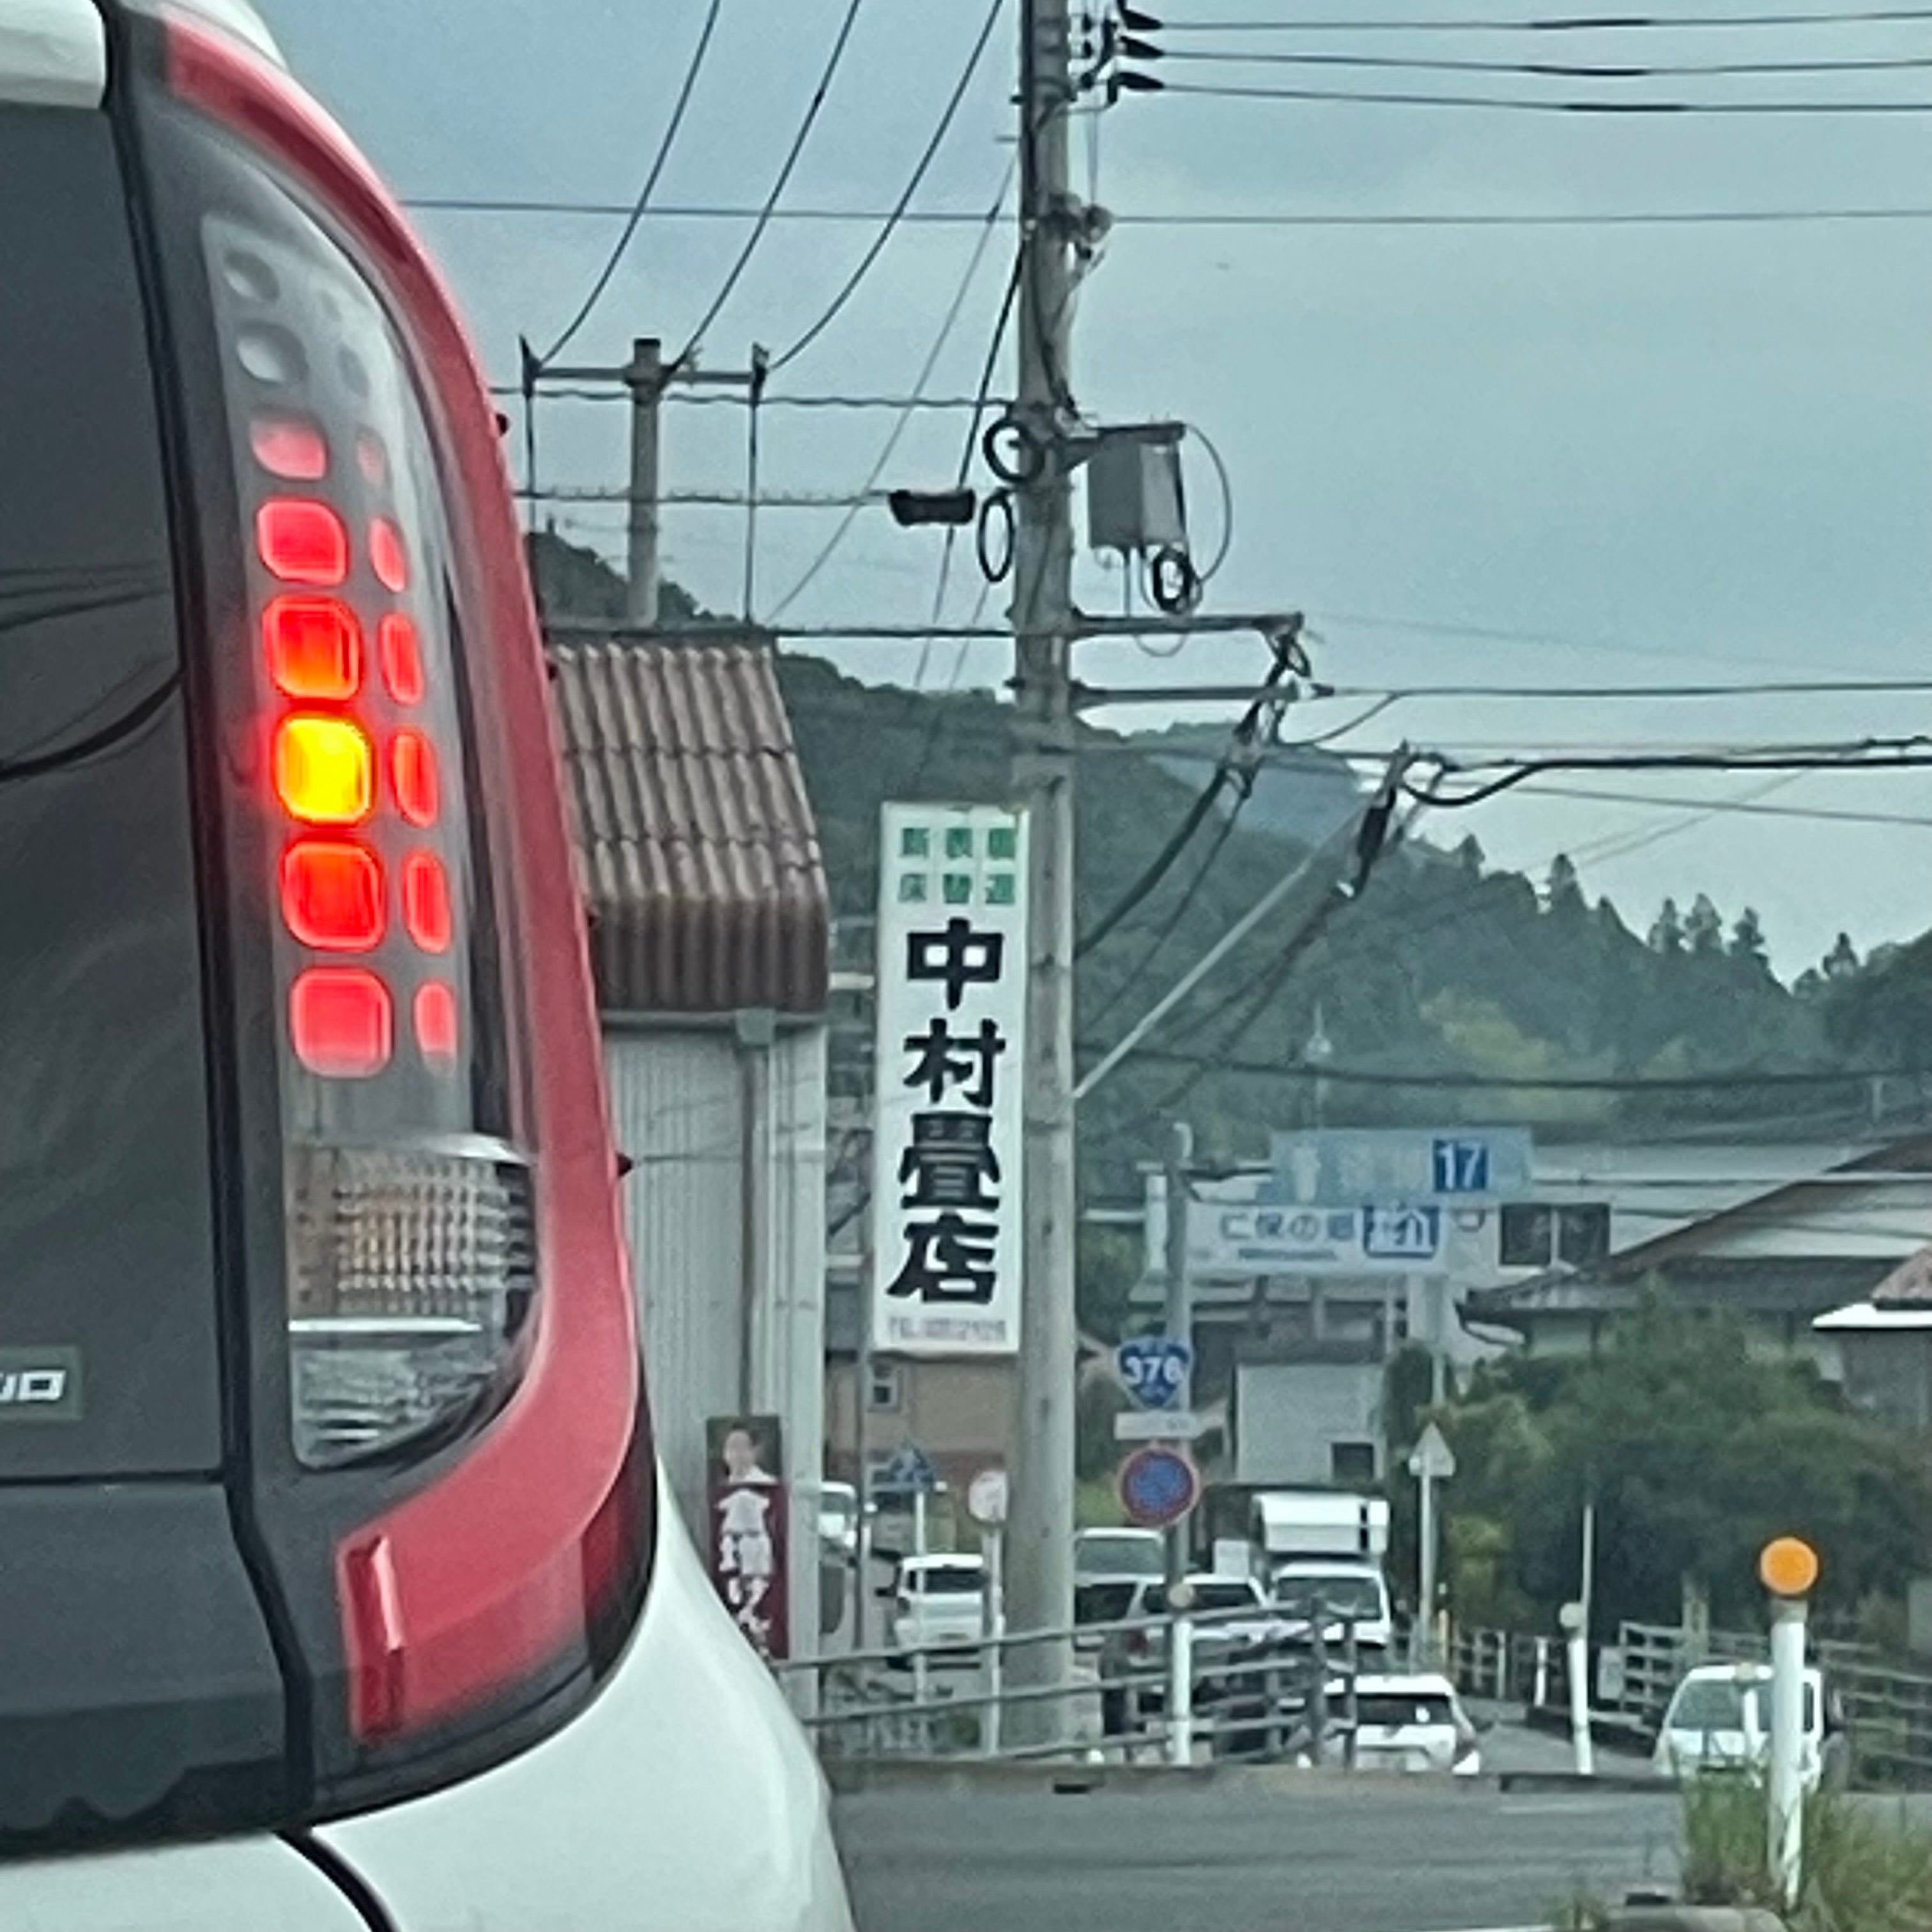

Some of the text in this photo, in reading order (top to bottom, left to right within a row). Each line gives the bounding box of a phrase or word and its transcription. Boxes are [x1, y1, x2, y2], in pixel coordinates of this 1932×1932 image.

[886, 917, 1006, 1305] 中村畳店
[1436, 1141, 1482, 1190] 17
